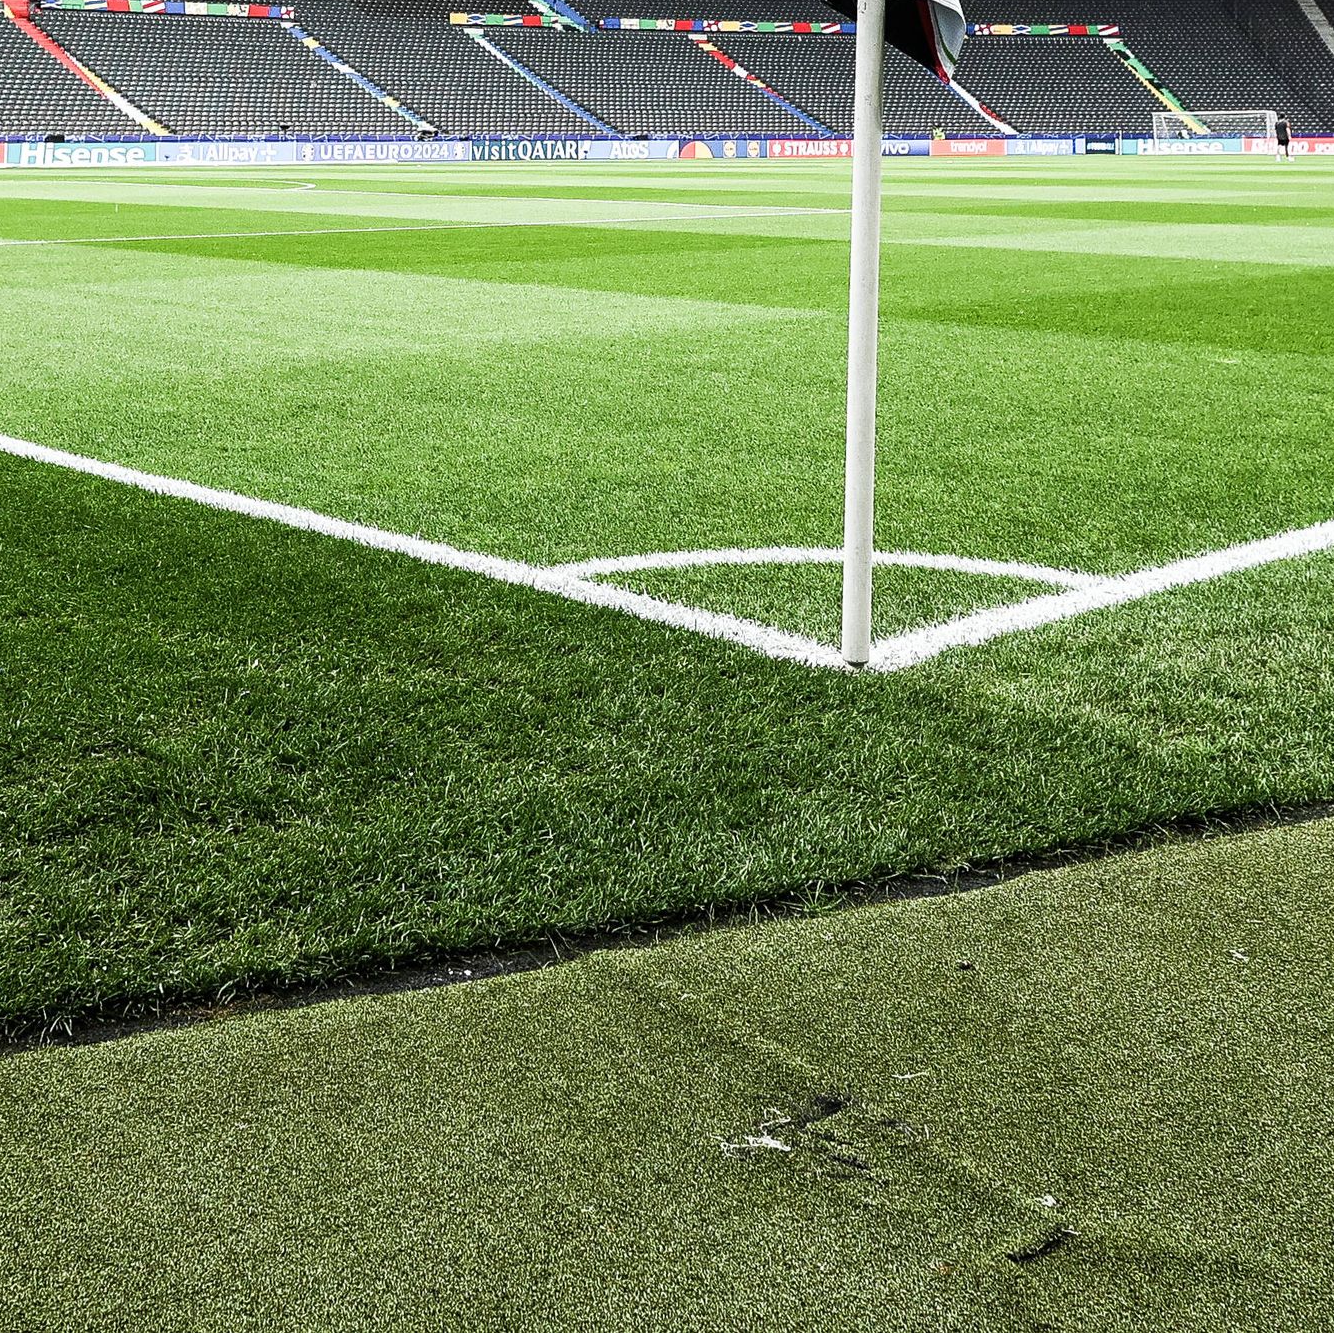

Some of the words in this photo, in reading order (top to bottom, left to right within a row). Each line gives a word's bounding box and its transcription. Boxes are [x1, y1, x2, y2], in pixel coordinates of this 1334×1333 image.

[21, 142, 145, 165] Hisense
[784, 142, 838, 155] STRAUSS
[950, 142, 987, 154] trendyol
